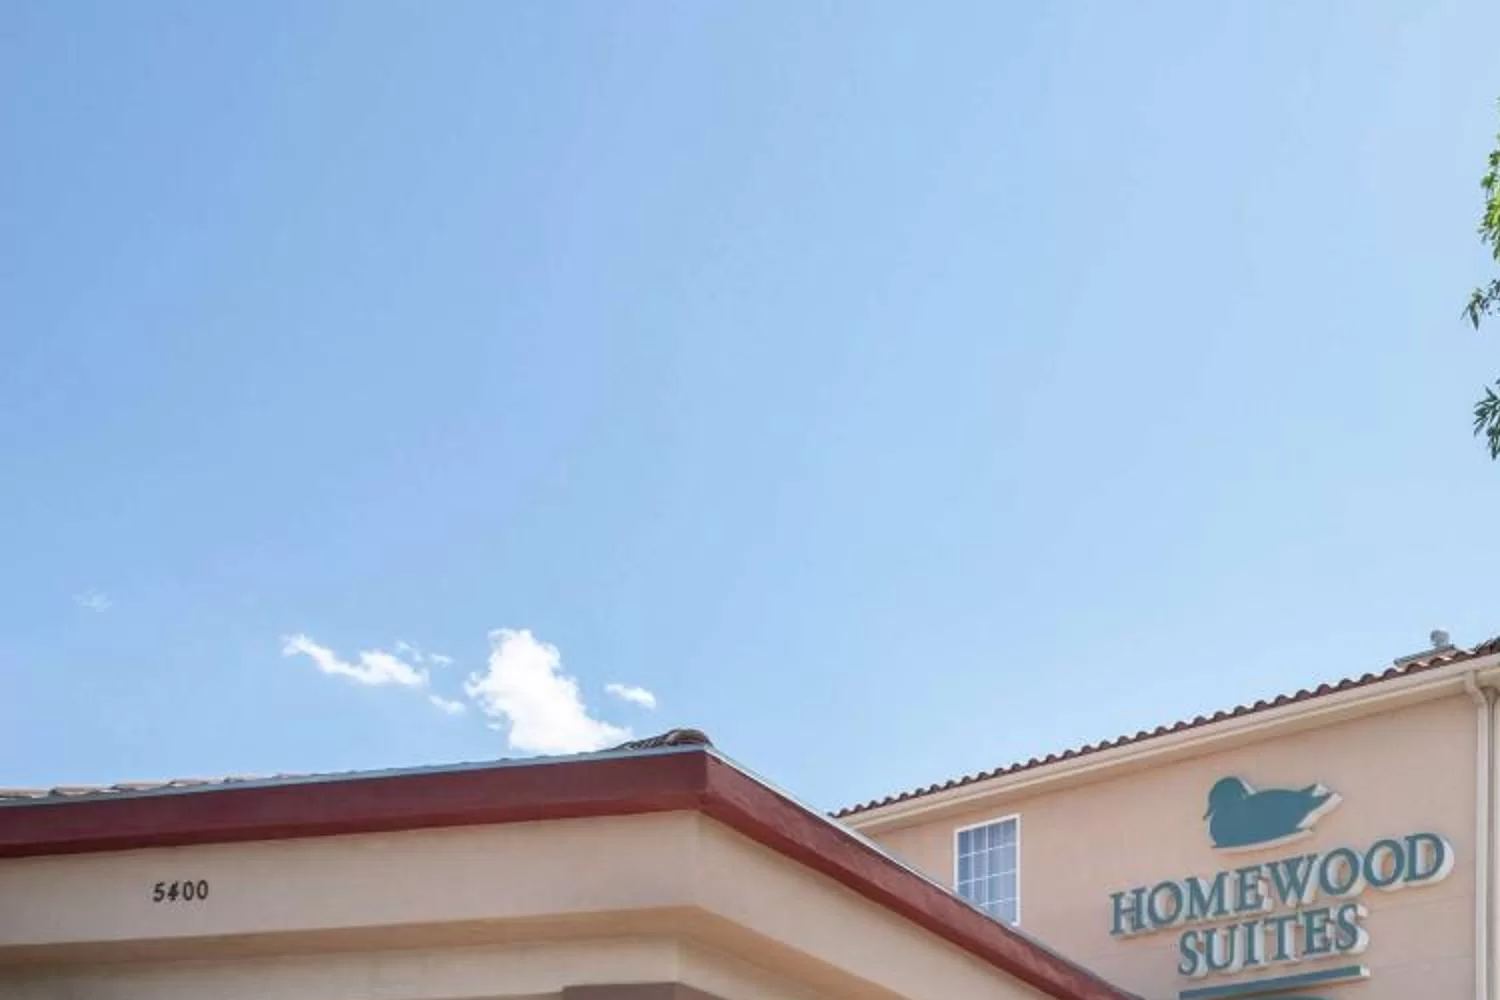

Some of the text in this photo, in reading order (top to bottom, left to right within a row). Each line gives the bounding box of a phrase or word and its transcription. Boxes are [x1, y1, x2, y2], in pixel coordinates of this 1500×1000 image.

[152, 879, 209, 902] 5400
[1109, 832, 1452, 937] HOMEWOOD
[1177, 903, 1366, 978] SUITES
